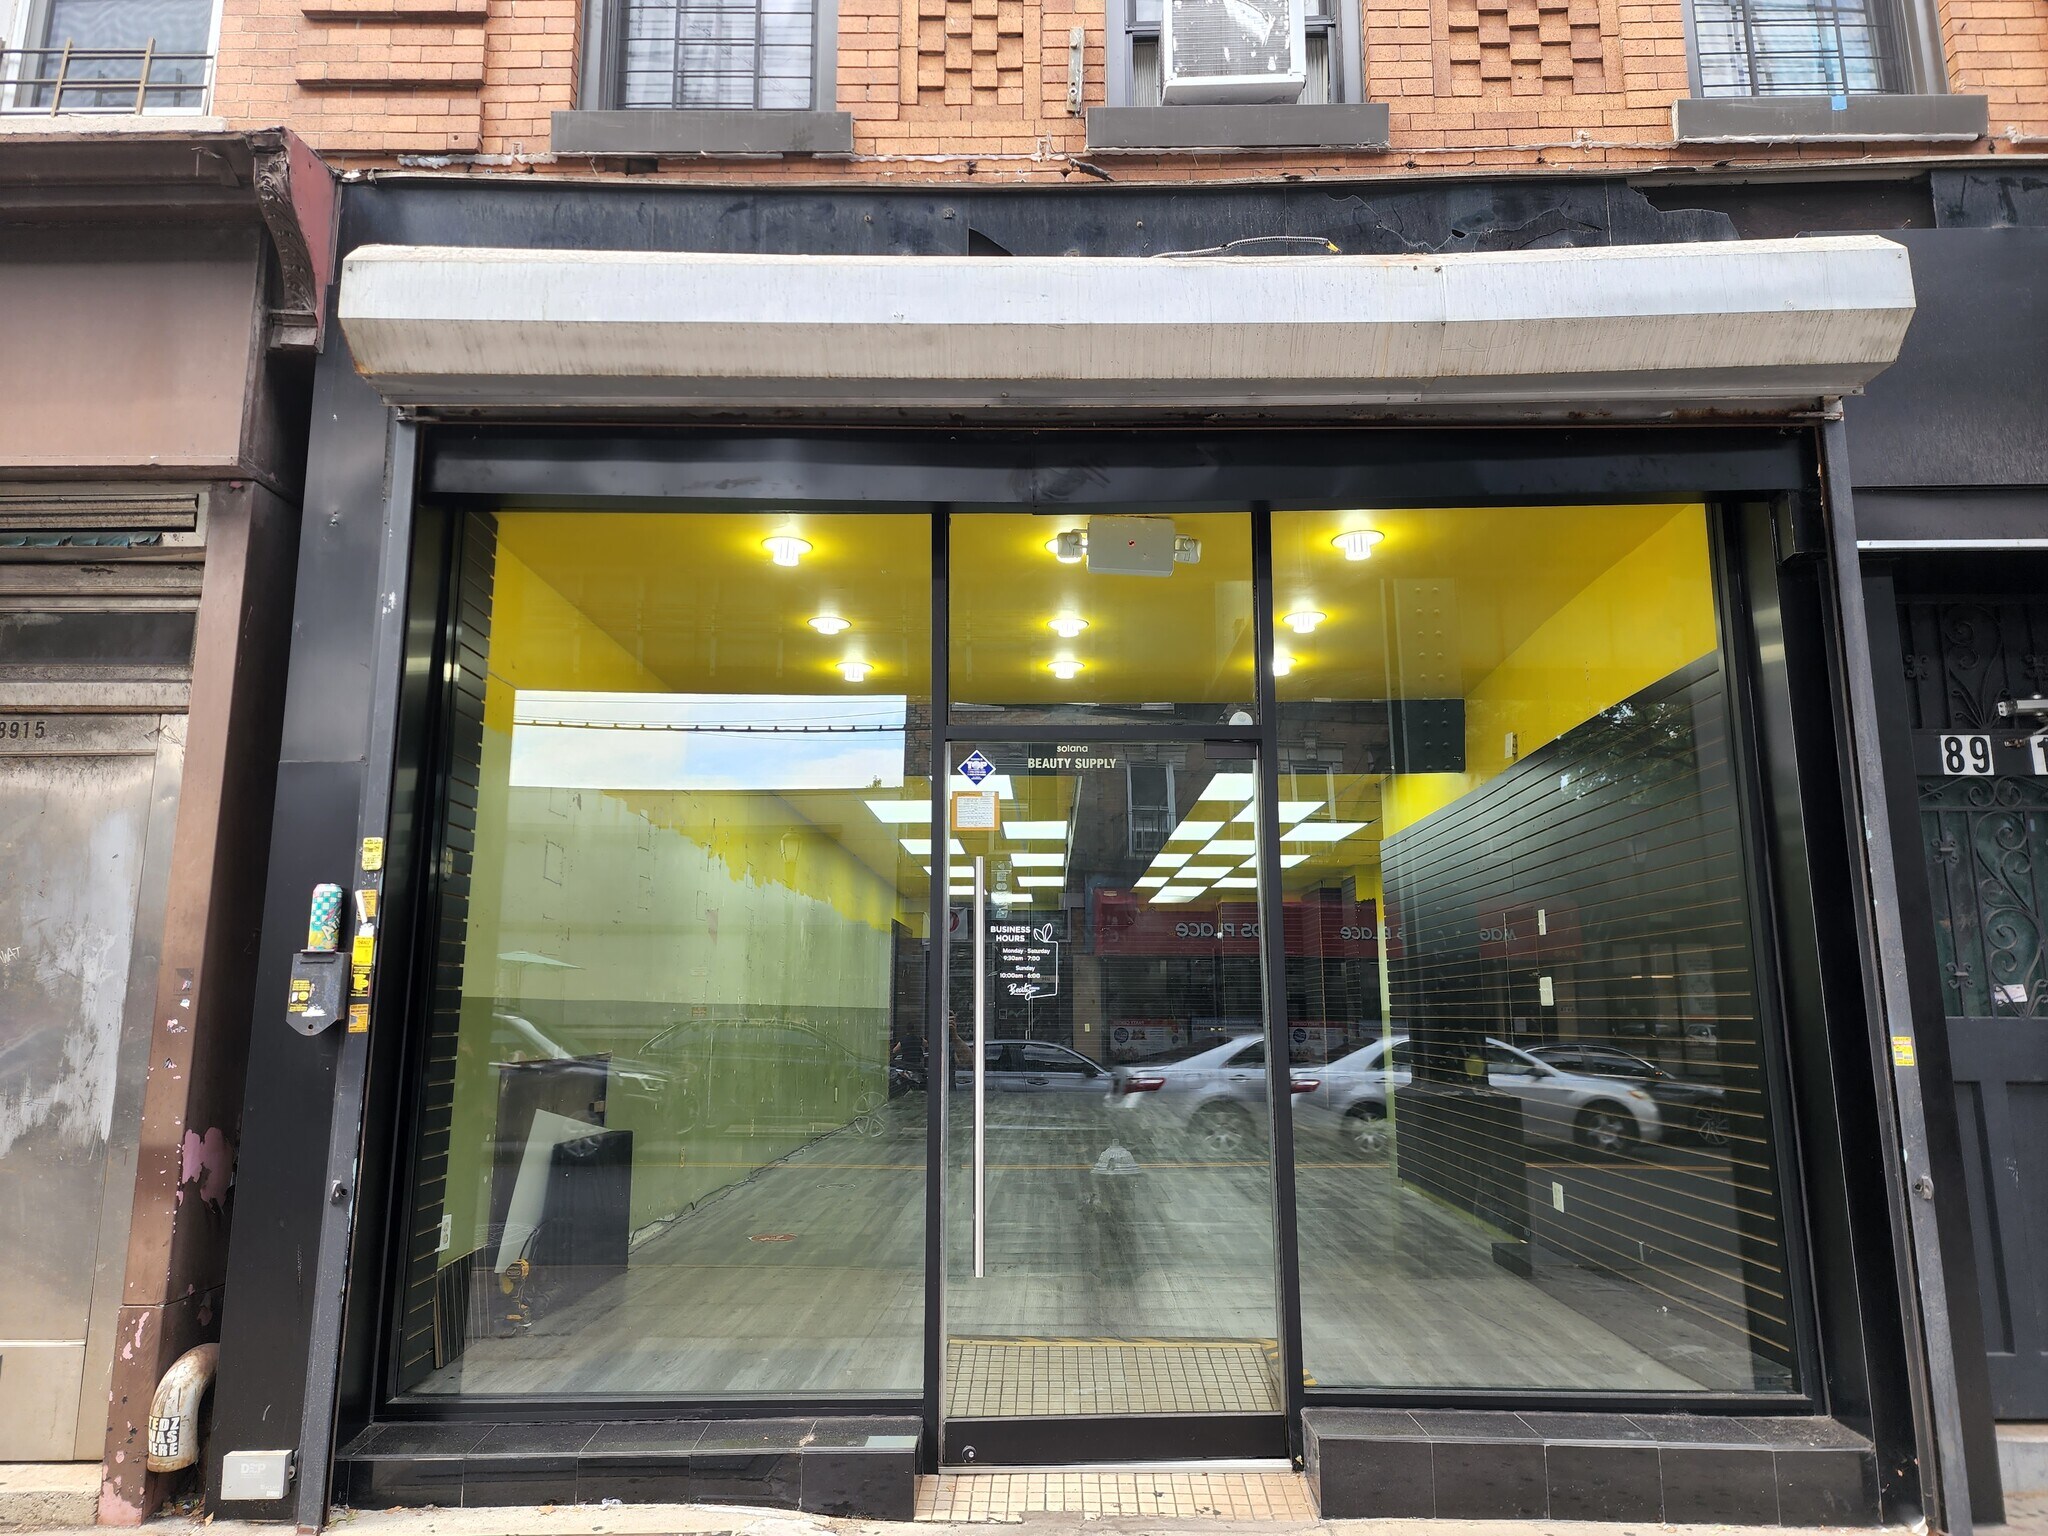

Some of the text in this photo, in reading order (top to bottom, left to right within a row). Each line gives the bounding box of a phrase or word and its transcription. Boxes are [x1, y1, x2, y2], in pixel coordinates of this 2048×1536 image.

[1944, 736, 1991, 773] 89
[1028, 758, 1117, 769] BEAUTY SUPPLY
[990, 925, 1031, 933] BUSINESS
[995, 934, 1026, 942] HOURS
[1027, 947, 1051, 955] Saturday
